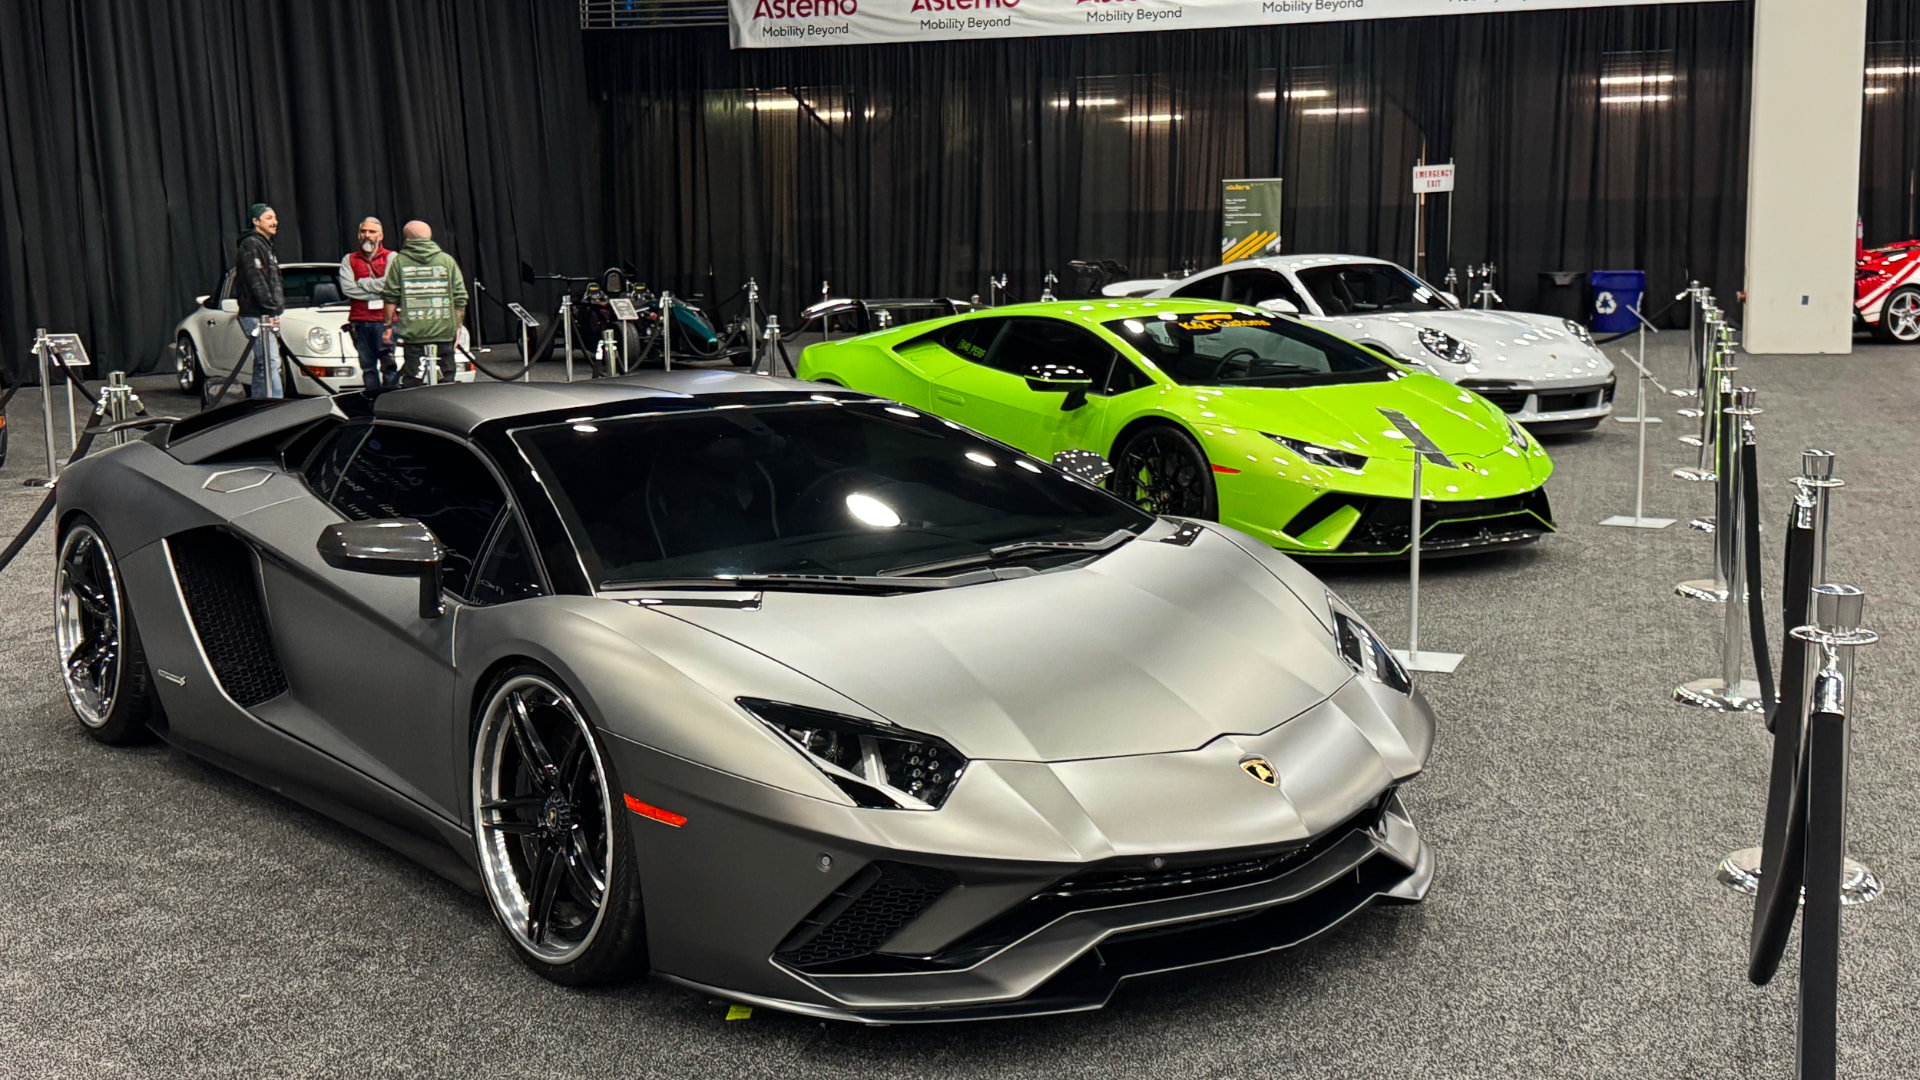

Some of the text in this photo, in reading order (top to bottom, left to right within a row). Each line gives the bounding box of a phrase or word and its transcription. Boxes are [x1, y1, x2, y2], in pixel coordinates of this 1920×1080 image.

[753, 0, 857, 20] Astemo
[1262, 0, 1363, 13] Mobility Beyond
[1087, 7, 1182, 23] Mobility Beyond
[763, 23, 849, 38] Mobility Beyond
[920, 15, 1011, 31] Mobility Beyond
[1415, 169, 1453, 179] EMERGENCY
[1427, 180, 1441, 188] EXIT
